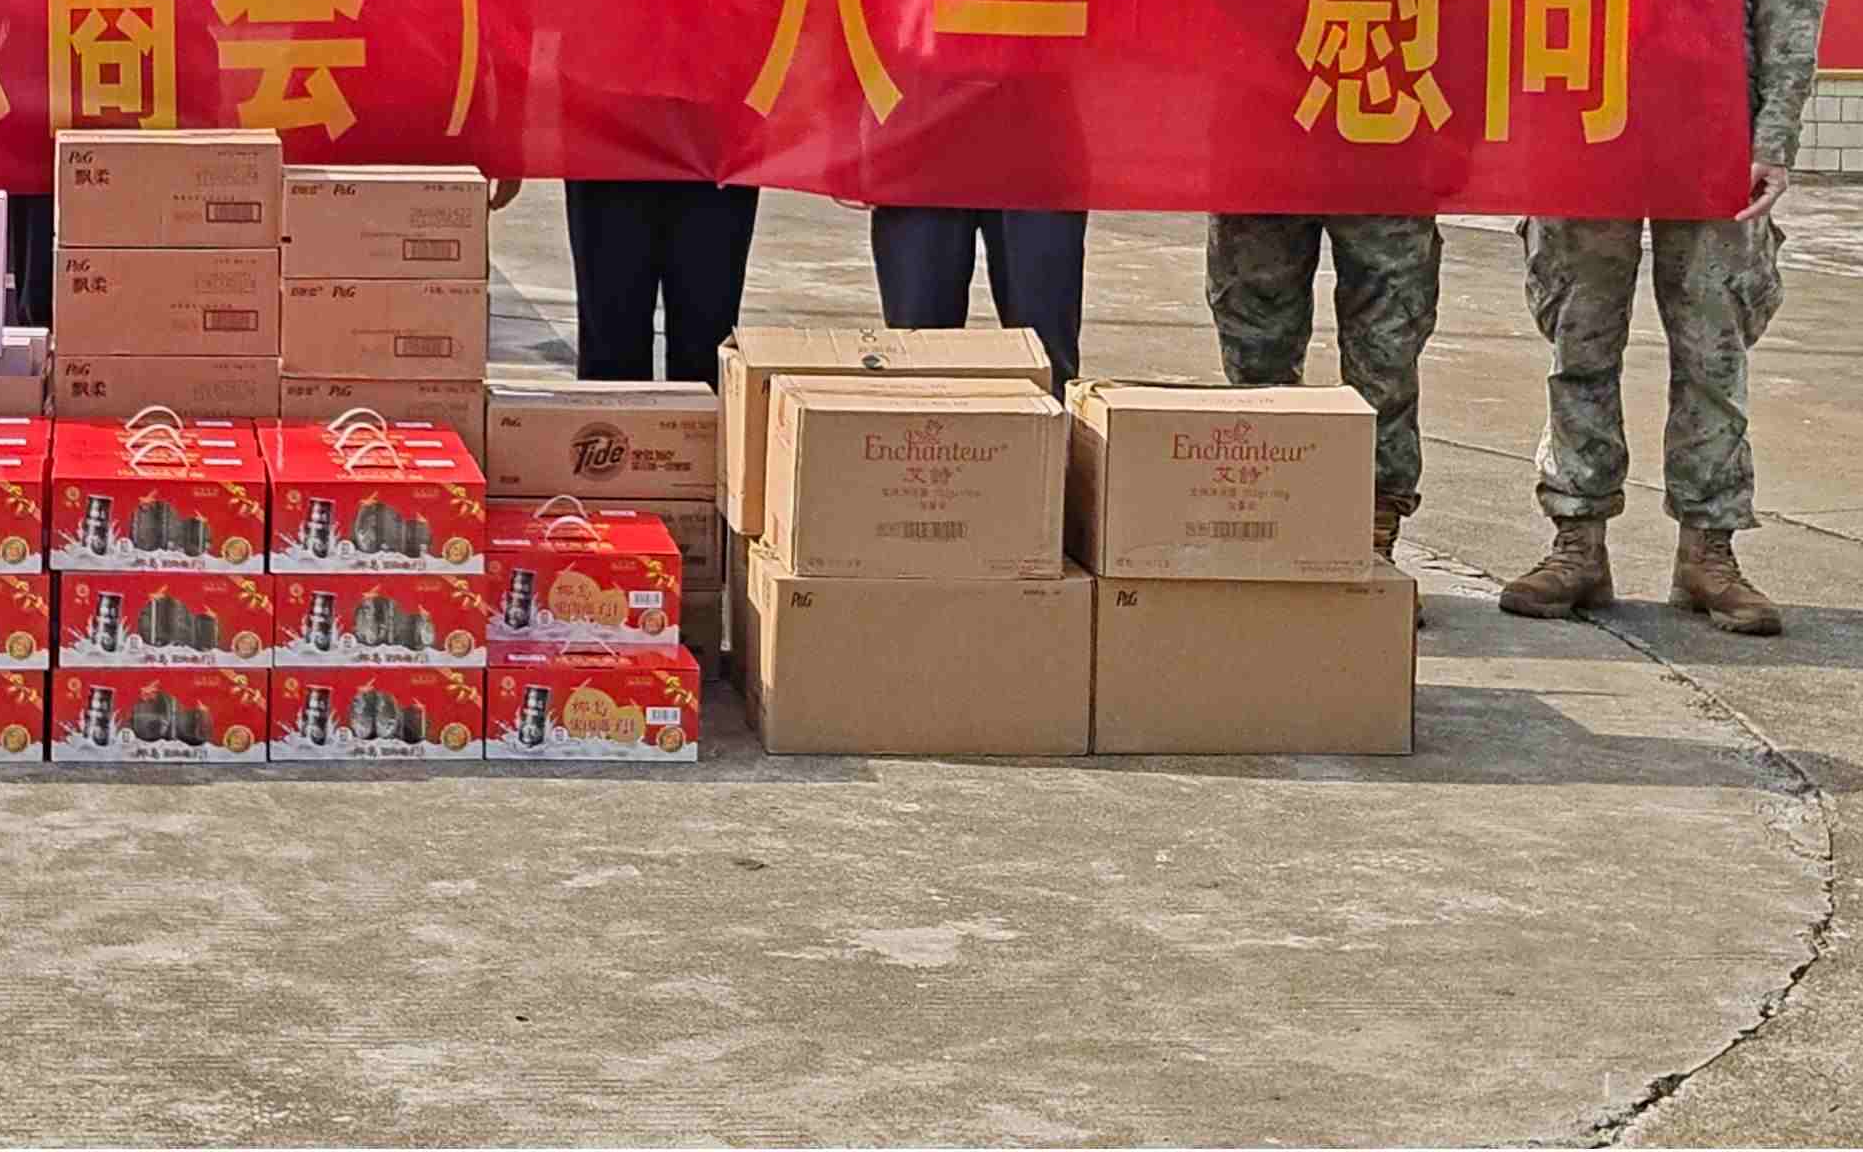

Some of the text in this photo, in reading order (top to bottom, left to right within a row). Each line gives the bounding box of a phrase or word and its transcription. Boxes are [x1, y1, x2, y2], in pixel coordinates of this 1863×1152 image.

[573, 439, 625, 475] Tide
[864, 433, 1000, 462] Enchanteur
[1171, 432, 1307, 462] Enchanteur
